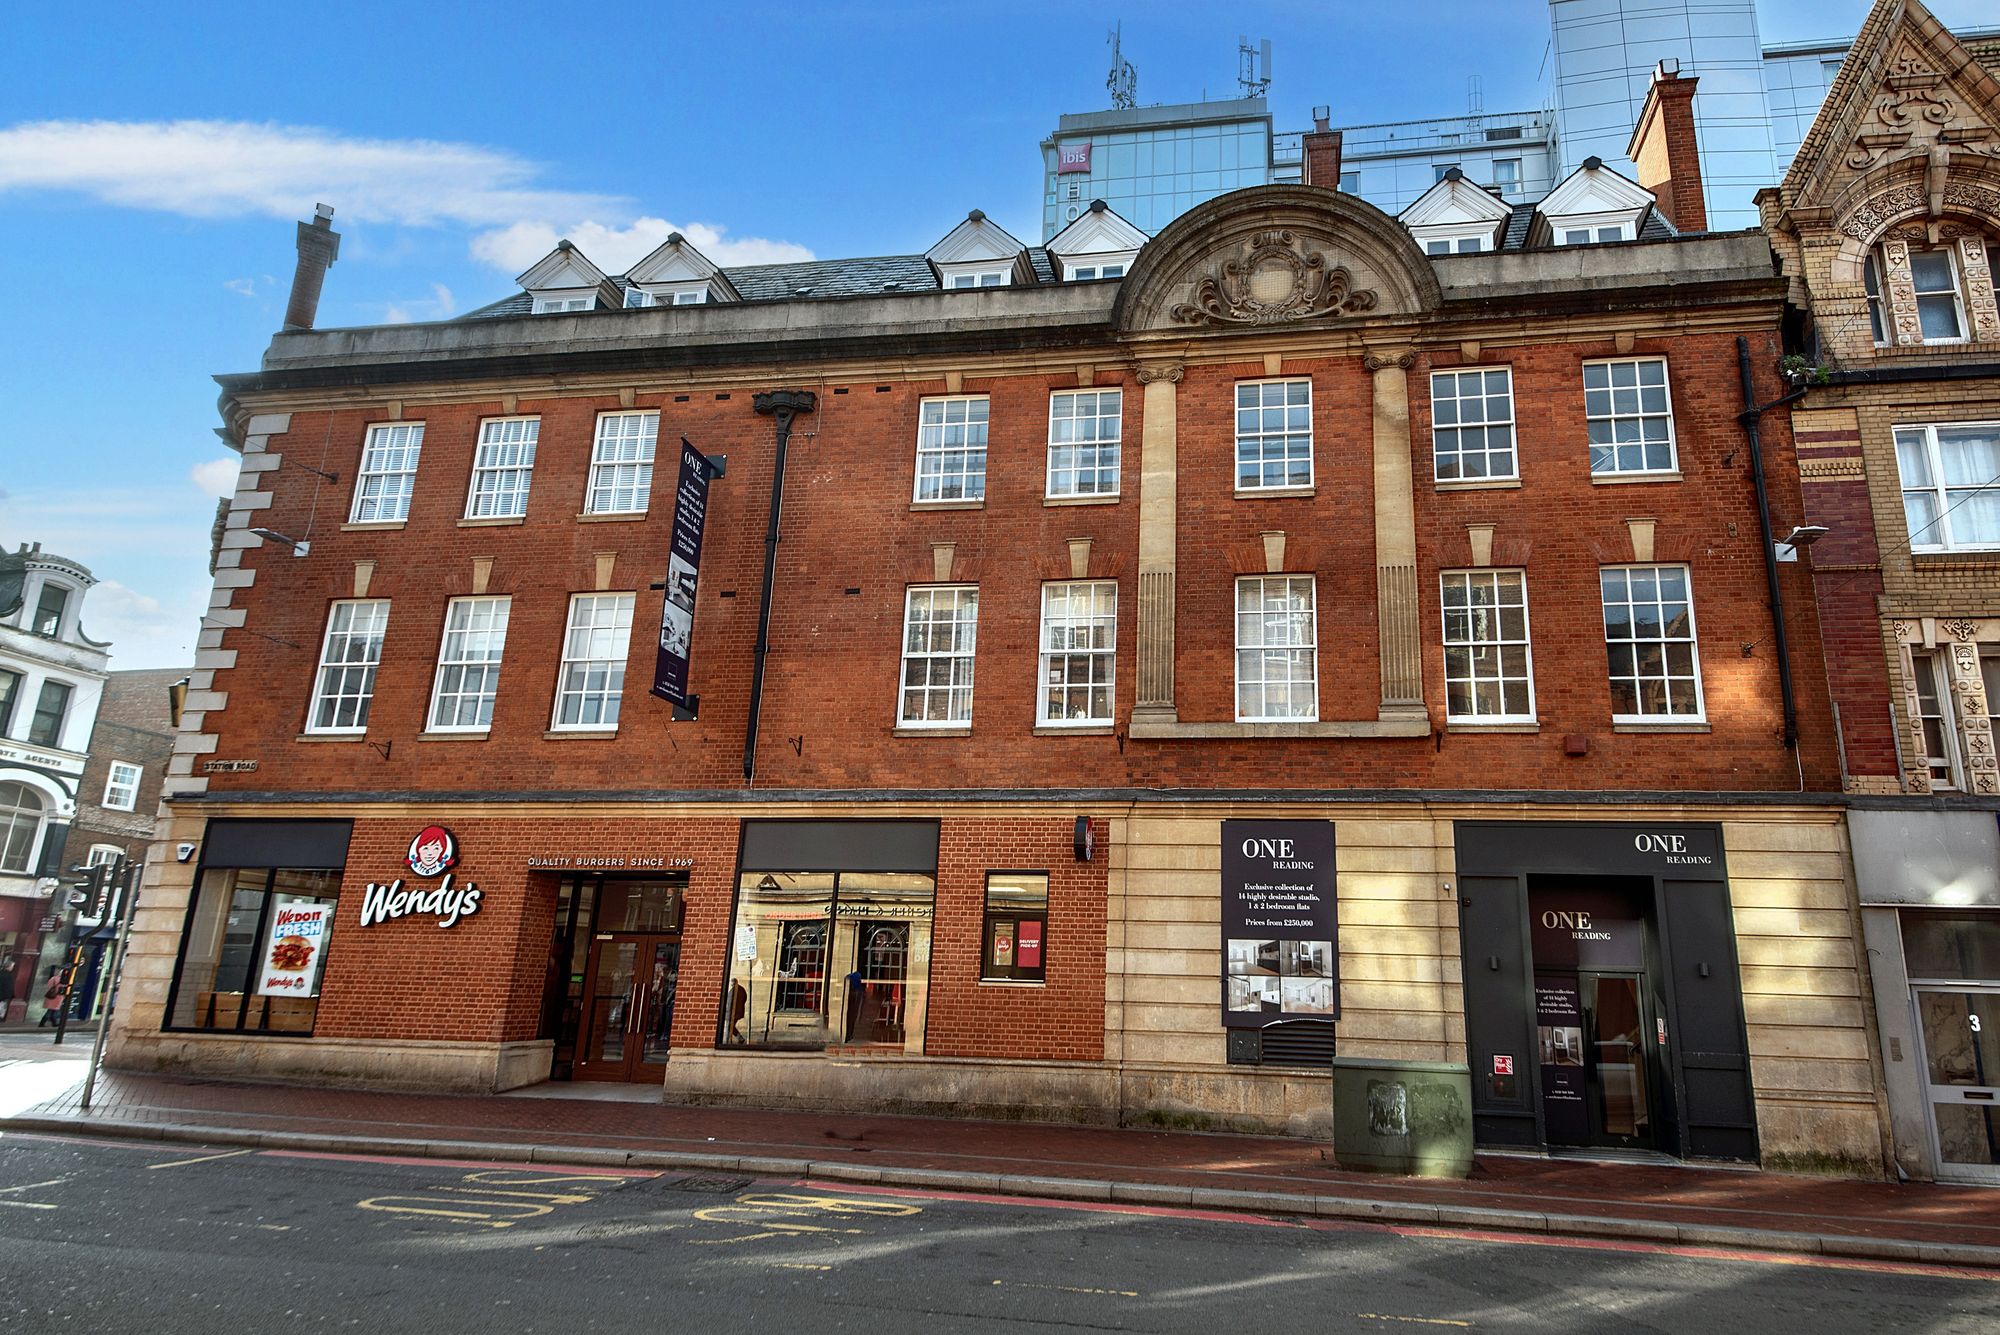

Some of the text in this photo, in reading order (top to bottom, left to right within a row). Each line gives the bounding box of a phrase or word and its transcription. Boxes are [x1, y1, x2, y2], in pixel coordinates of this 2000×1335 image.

[1063, 151, 1086, 164] ibis
[684, 451, 702, 475] ONE
[24, 753, 62, 767] AGENTS
[203, 761, 256, 770] STATION ROAD
[1242, 838, 1295, 859] ONE
[1635, 833, 1687, 853] ONE
[527, 857, 693, 867] QUALITY BURGERS SINCE 1969
[1272, 861, 1314, 870] READING
[1666, 855, 1712, 864] READING
[1244, 882, 1274, 891] Exclusive
[1274, 883, 1305, 891] collection
[360, 873, 481, 928] Wendy's
[1246, 892, 1267, 902] highly
[1268, 893, 1297, 901] desirable
[1266, 902, 1296, 910] bedroom
[277, 908, 322, 926] We DO IT
[764, 911, 797, 920] ORDER
[1245, 917, 1314, 927] Prices from £250,000
[1541, 910, 1592, 930] ONE
[275, 921, 321, 937] FRESH
[1571, 931, 1611, 940] READING
[266, 976, 294, 989] Wendy's
[1968, 1014, 1981, 1032] 3
